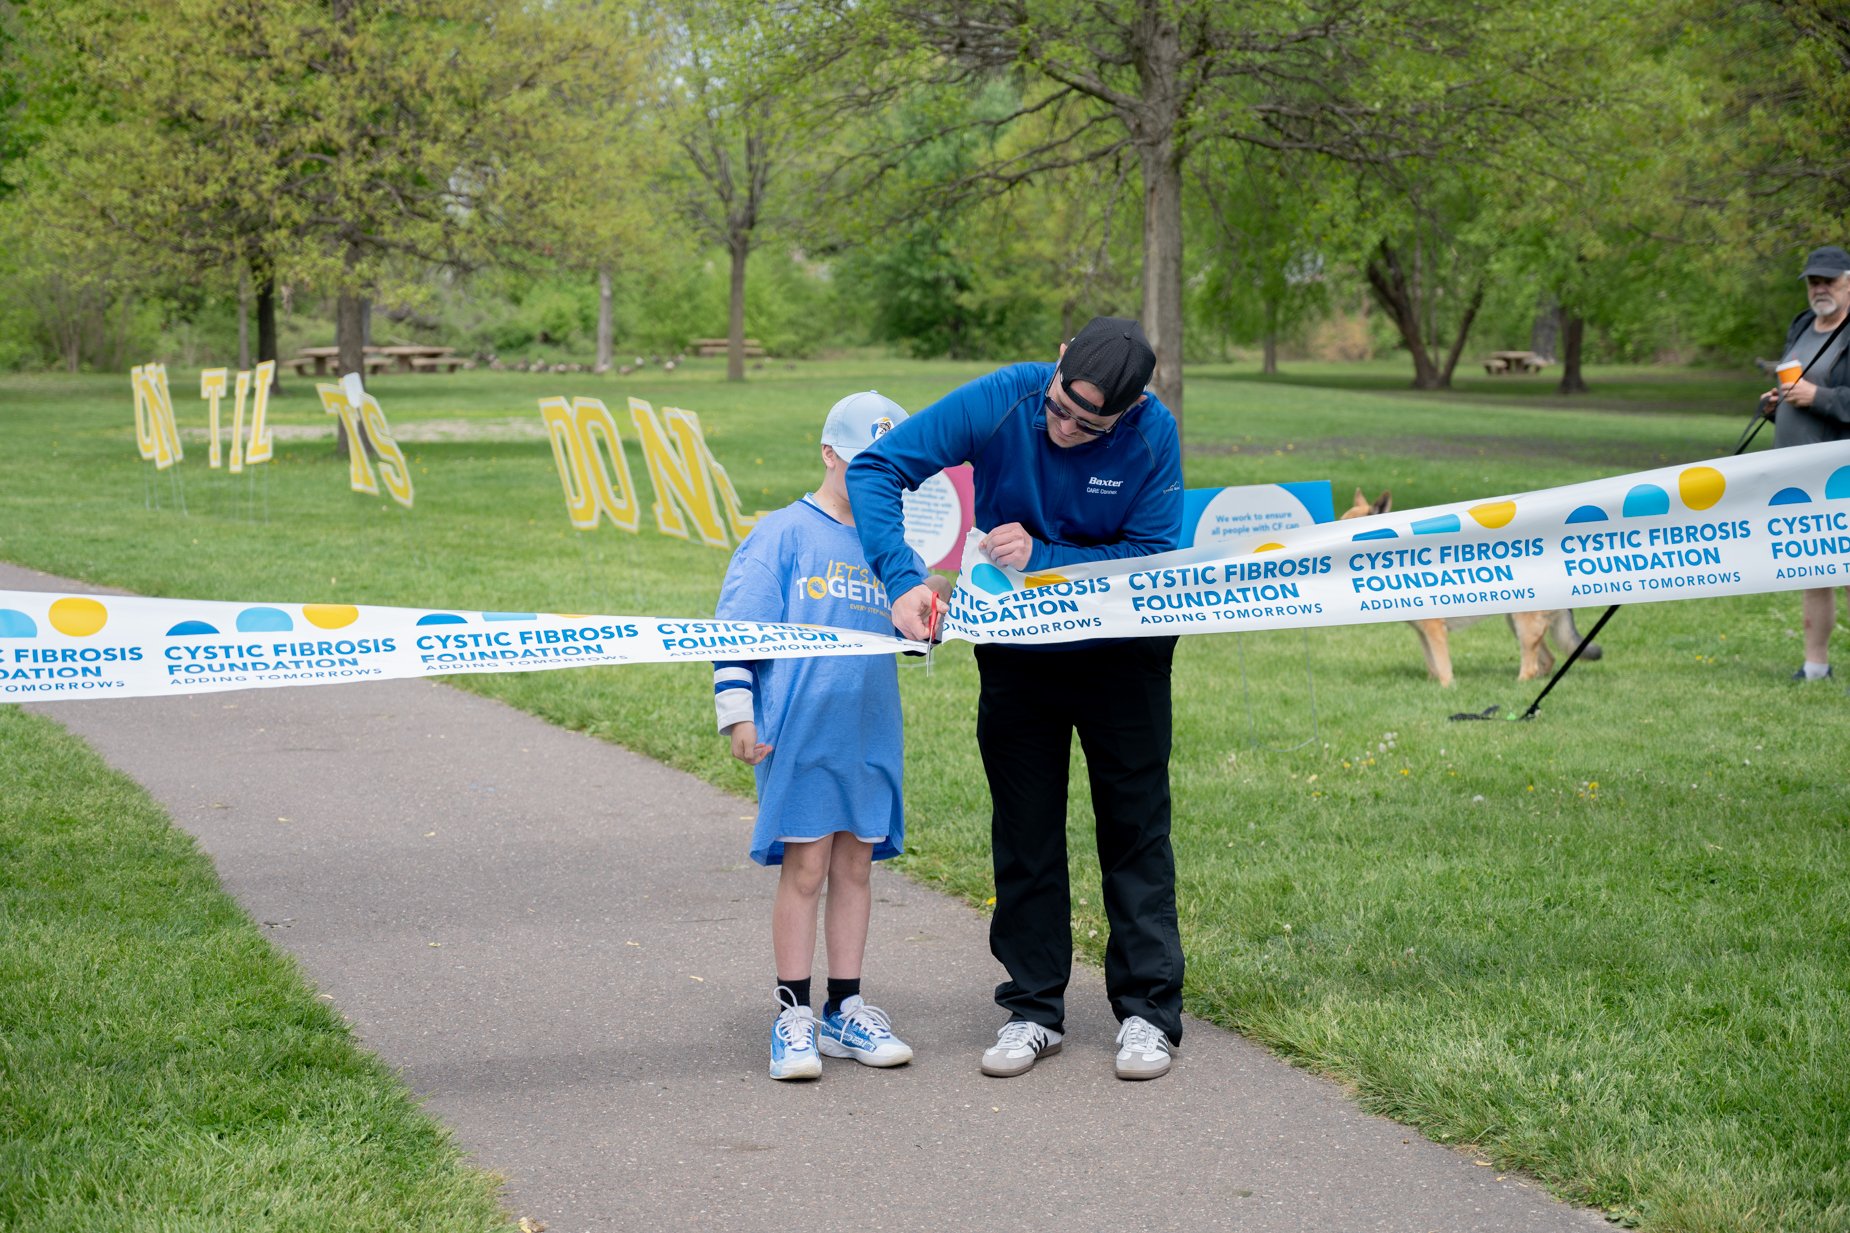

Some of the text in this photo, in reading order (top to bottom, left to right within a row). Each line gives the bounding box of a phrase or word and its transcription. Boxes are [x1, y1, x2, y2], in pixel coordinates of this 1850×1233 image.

[1088, 476, 1124, 488] Baxter
[1215, 511, 1292, 523] We work to ensure
[1767, 512, 1848, 536] CYSTIC
[1211, 521, 1300, 537] all people with CF can
[1560, 520, 1751, 554] CYSTIC FIBROSIS
[1348, 537, 1545, 572] CYSTIC FIBROSIS
[1564, 547, 1721, 577] FOUNDATION
[826, 559, 869, 583] LET'S
[1129, 555, 1332, 591] CYSTIC FIBROSIS
[1351, 564, 1514, 593] FOUNDATION
[1776, 563, 1837, 579] ADDING
[1571, 571, 1742, 596] ADDING TOMORROWS
[1131, 582, 1300, 612] FOUNDATION
[1360, 587, 1536, 611] ADDING TOMORROWS
[948, 600, 1079, 626] UNDATION
[1140, 603, 1324, 625] ADDING TOMORROWS
[416, 624, 639, 651] CYSTIC FIBROSIS
[656, 622, 750, 635] CYSTIC
[986, 617, 1102, 637] TOMORROWS
[164, 637, 397, 660] CYSTIC FIBROSIS
[662, 631, 839, 650] FOUNDATION
[669, 642, 864, 657] ADDING TOMORROWS
[14, 647, 144, 663] FIBROSIS
[420, 644, 604, 664] FOUNDATION
[425, 655, 628, 671] ADDING TOMORROWS
[167, 658, 359, 675] FOUNDATION
[170, 668, 383, 685] ADDING TOMORROWS
[0, 681, 125, 692] OMORROWS
